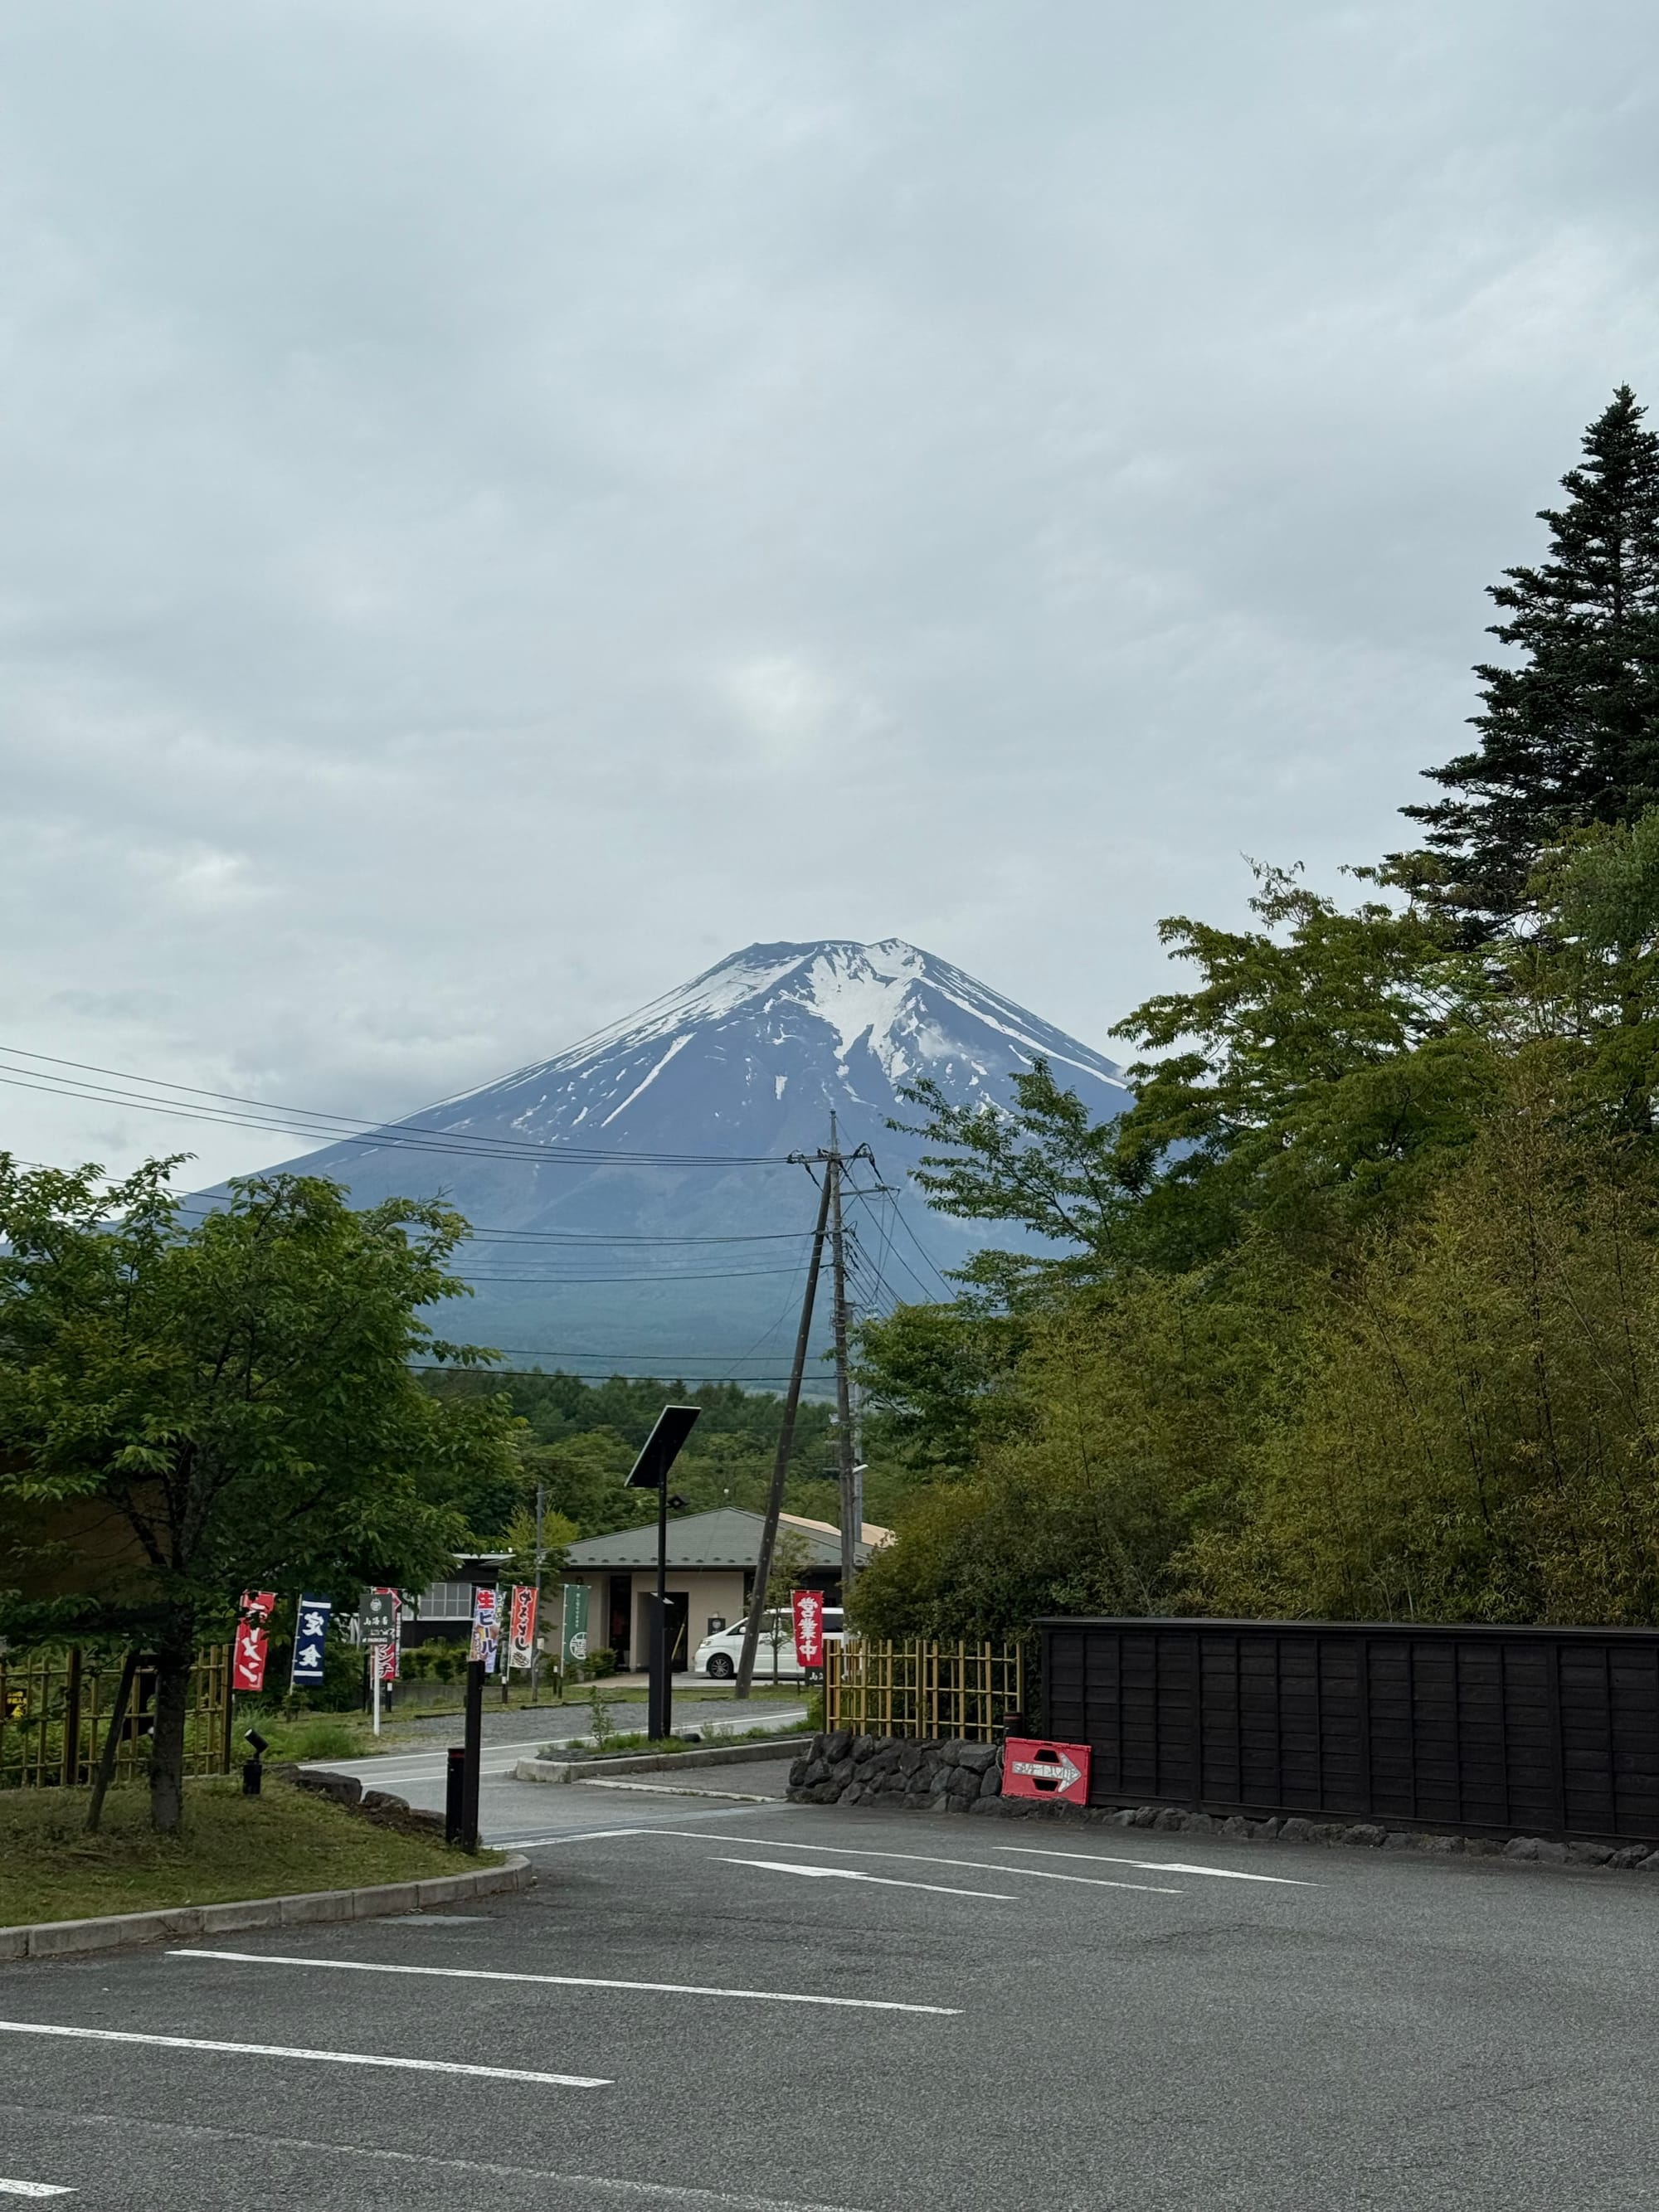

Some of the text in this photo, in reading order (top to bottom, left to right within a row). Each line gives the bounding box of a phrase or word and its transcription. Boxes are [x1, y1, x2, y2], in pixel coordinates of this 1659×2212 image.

[477, 1590, 498, 1653] 生ビール
[797, 1597, 819, 1661] 営業中
